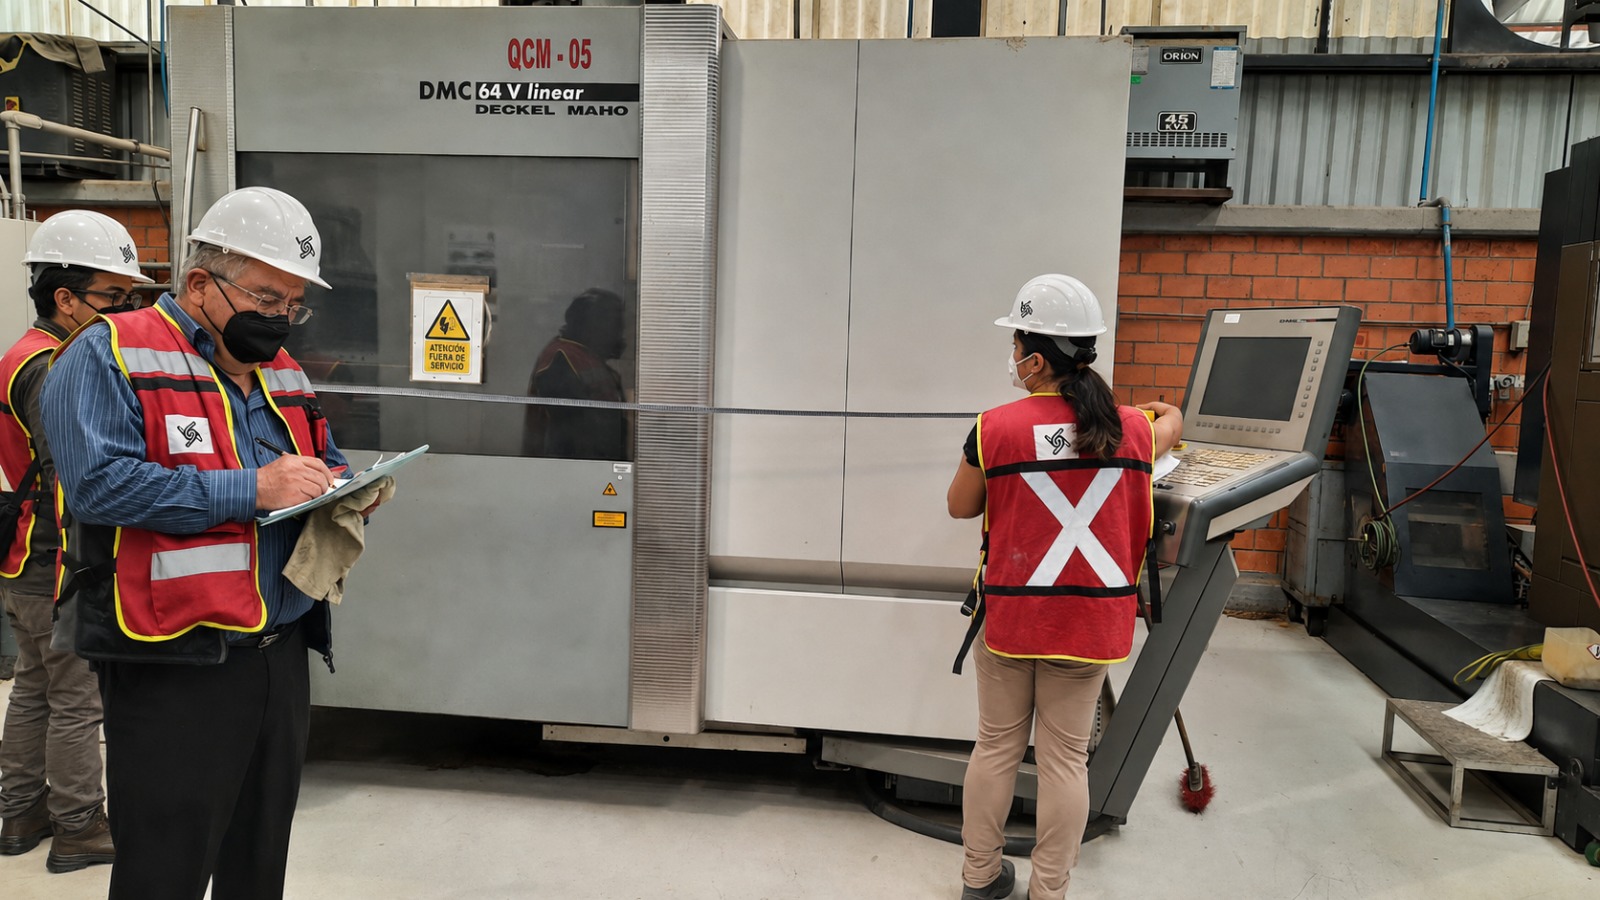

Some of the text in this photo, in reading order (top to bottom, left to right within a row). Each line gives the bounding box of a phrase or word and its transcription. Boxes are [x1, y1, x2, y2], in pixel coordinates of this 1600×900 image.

[508, 38, 551, 70] QCM
[569, 38, 592, 69] 05
[1164, 52, 1199, 60] ORION
[419, 81, 584, 100] DMC 64 V linear
[476, 104, 629, 116] DECKEL MAHO
[1164, 114, 1189, 124] 45
[430, 344, 464, 352] ATENCIÓN
[429, 353, 453, 361] FUERA
[430, 362, 464, 370] SERVICIO
